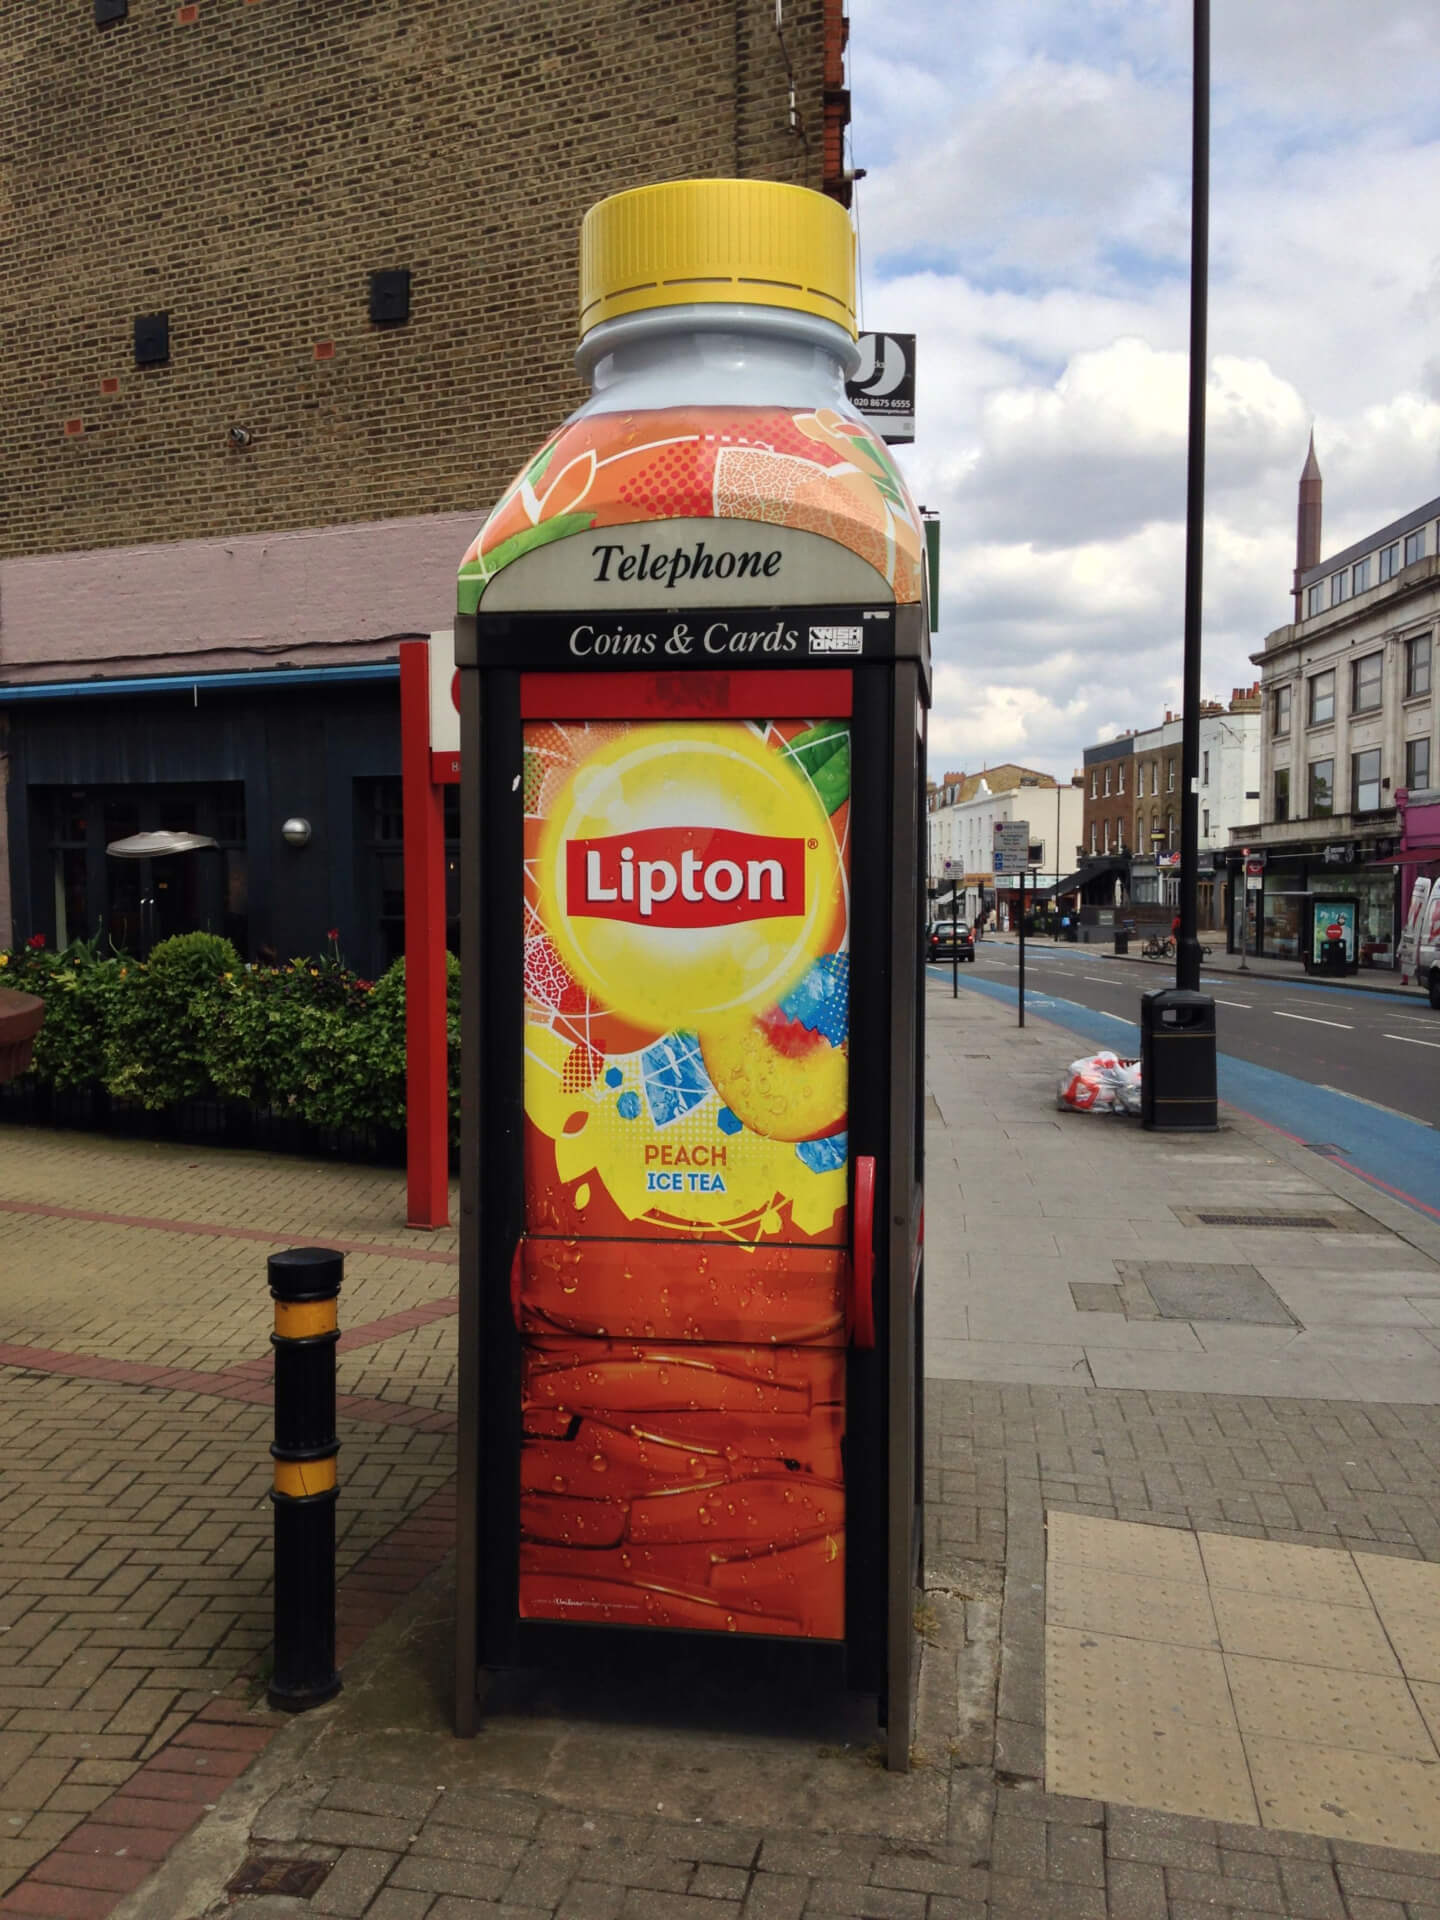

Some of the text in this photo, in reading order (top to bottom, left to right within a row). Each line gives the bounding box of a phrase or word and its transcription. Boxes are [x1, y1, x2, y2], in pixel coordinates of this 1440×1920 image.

[854, 398, 869, 406] 020
[592, 543, 783, 588] Telephone
[568, 622, 799, 657] Coins & Cards
[587, 846, 785, 916] Lipton
[644, 1144, 727, 1167] PEACH
[647, 1172, 726, 1192] ICE TEA
